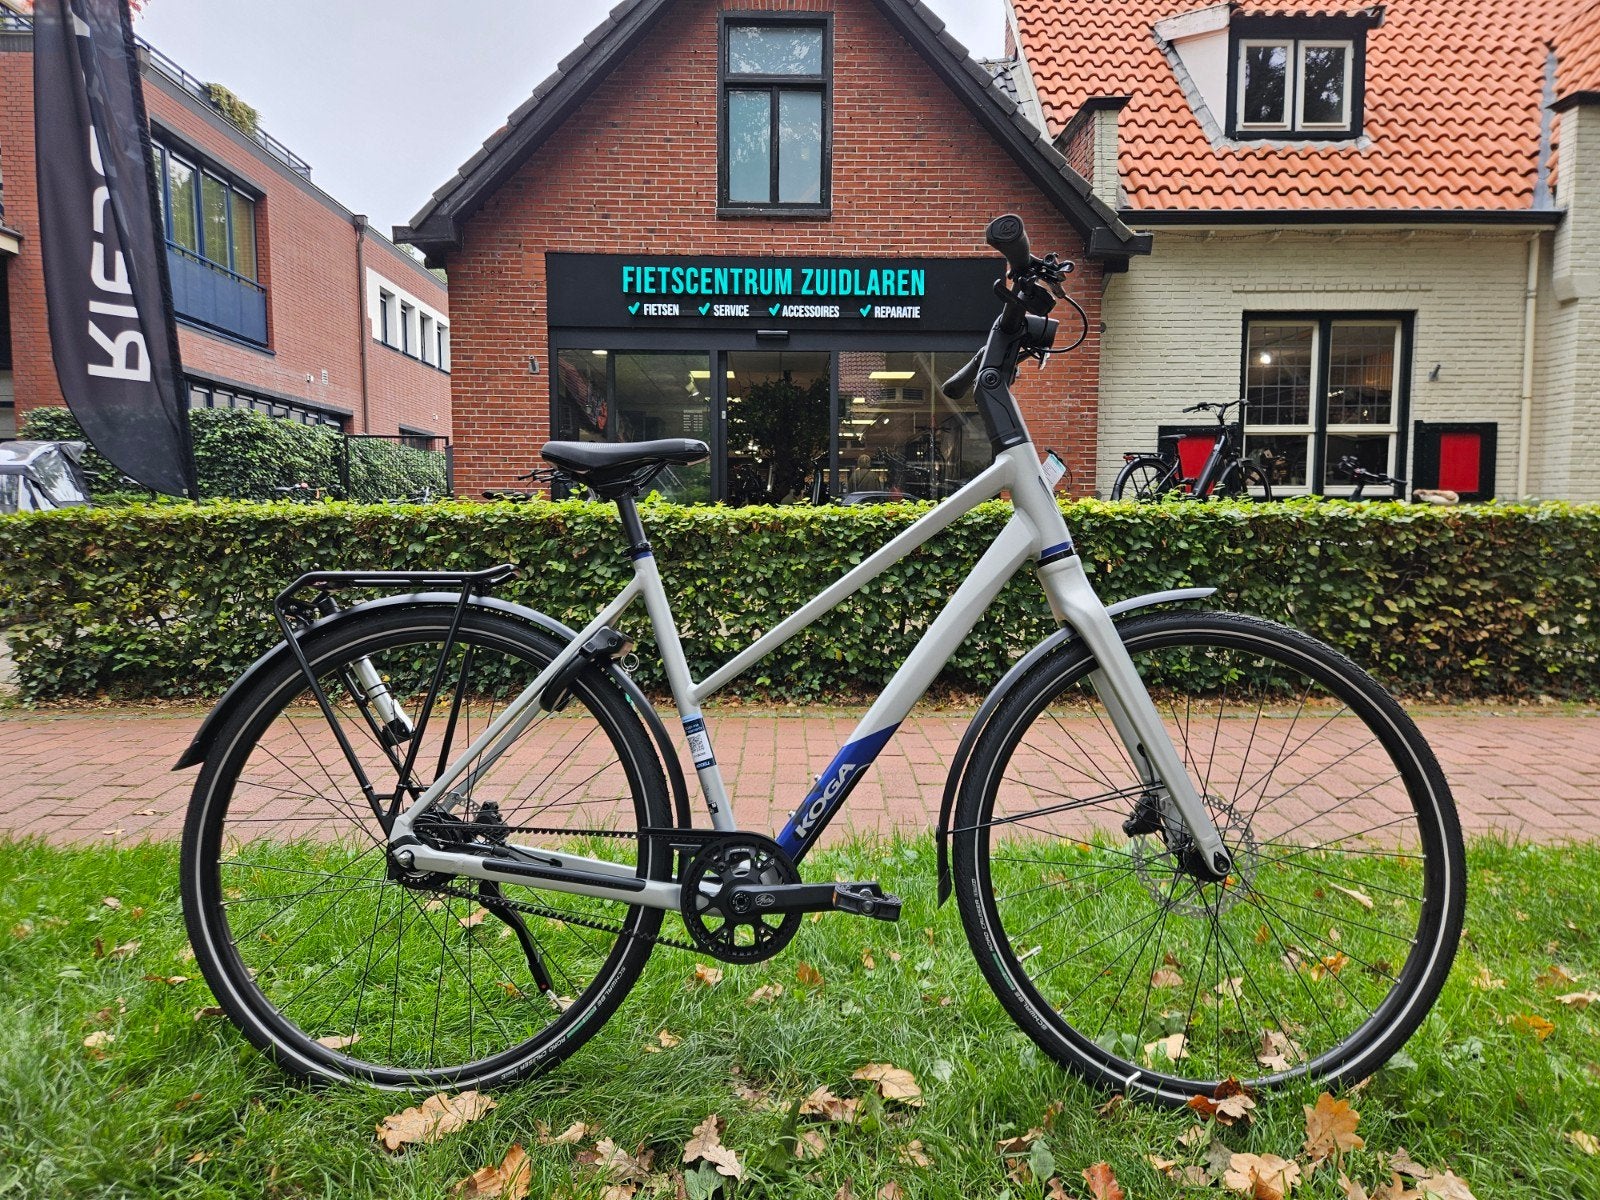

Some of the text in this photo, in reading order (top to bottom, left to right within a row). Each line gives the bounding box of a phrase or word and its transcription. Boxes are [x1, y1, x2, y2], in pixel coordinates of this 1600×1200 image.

[622, 266, 926, 297] FIETSCENTRUM ZUIDLAREN
[643, 303, 680, 316] FIETSEN
[713, 304, 750, 317] SERVICE
[782, 304, 840, 318] ACCESSOIRES
[874, 305, 921, 319] REPARATIE
[794, 763, 856, 839] KOGA
